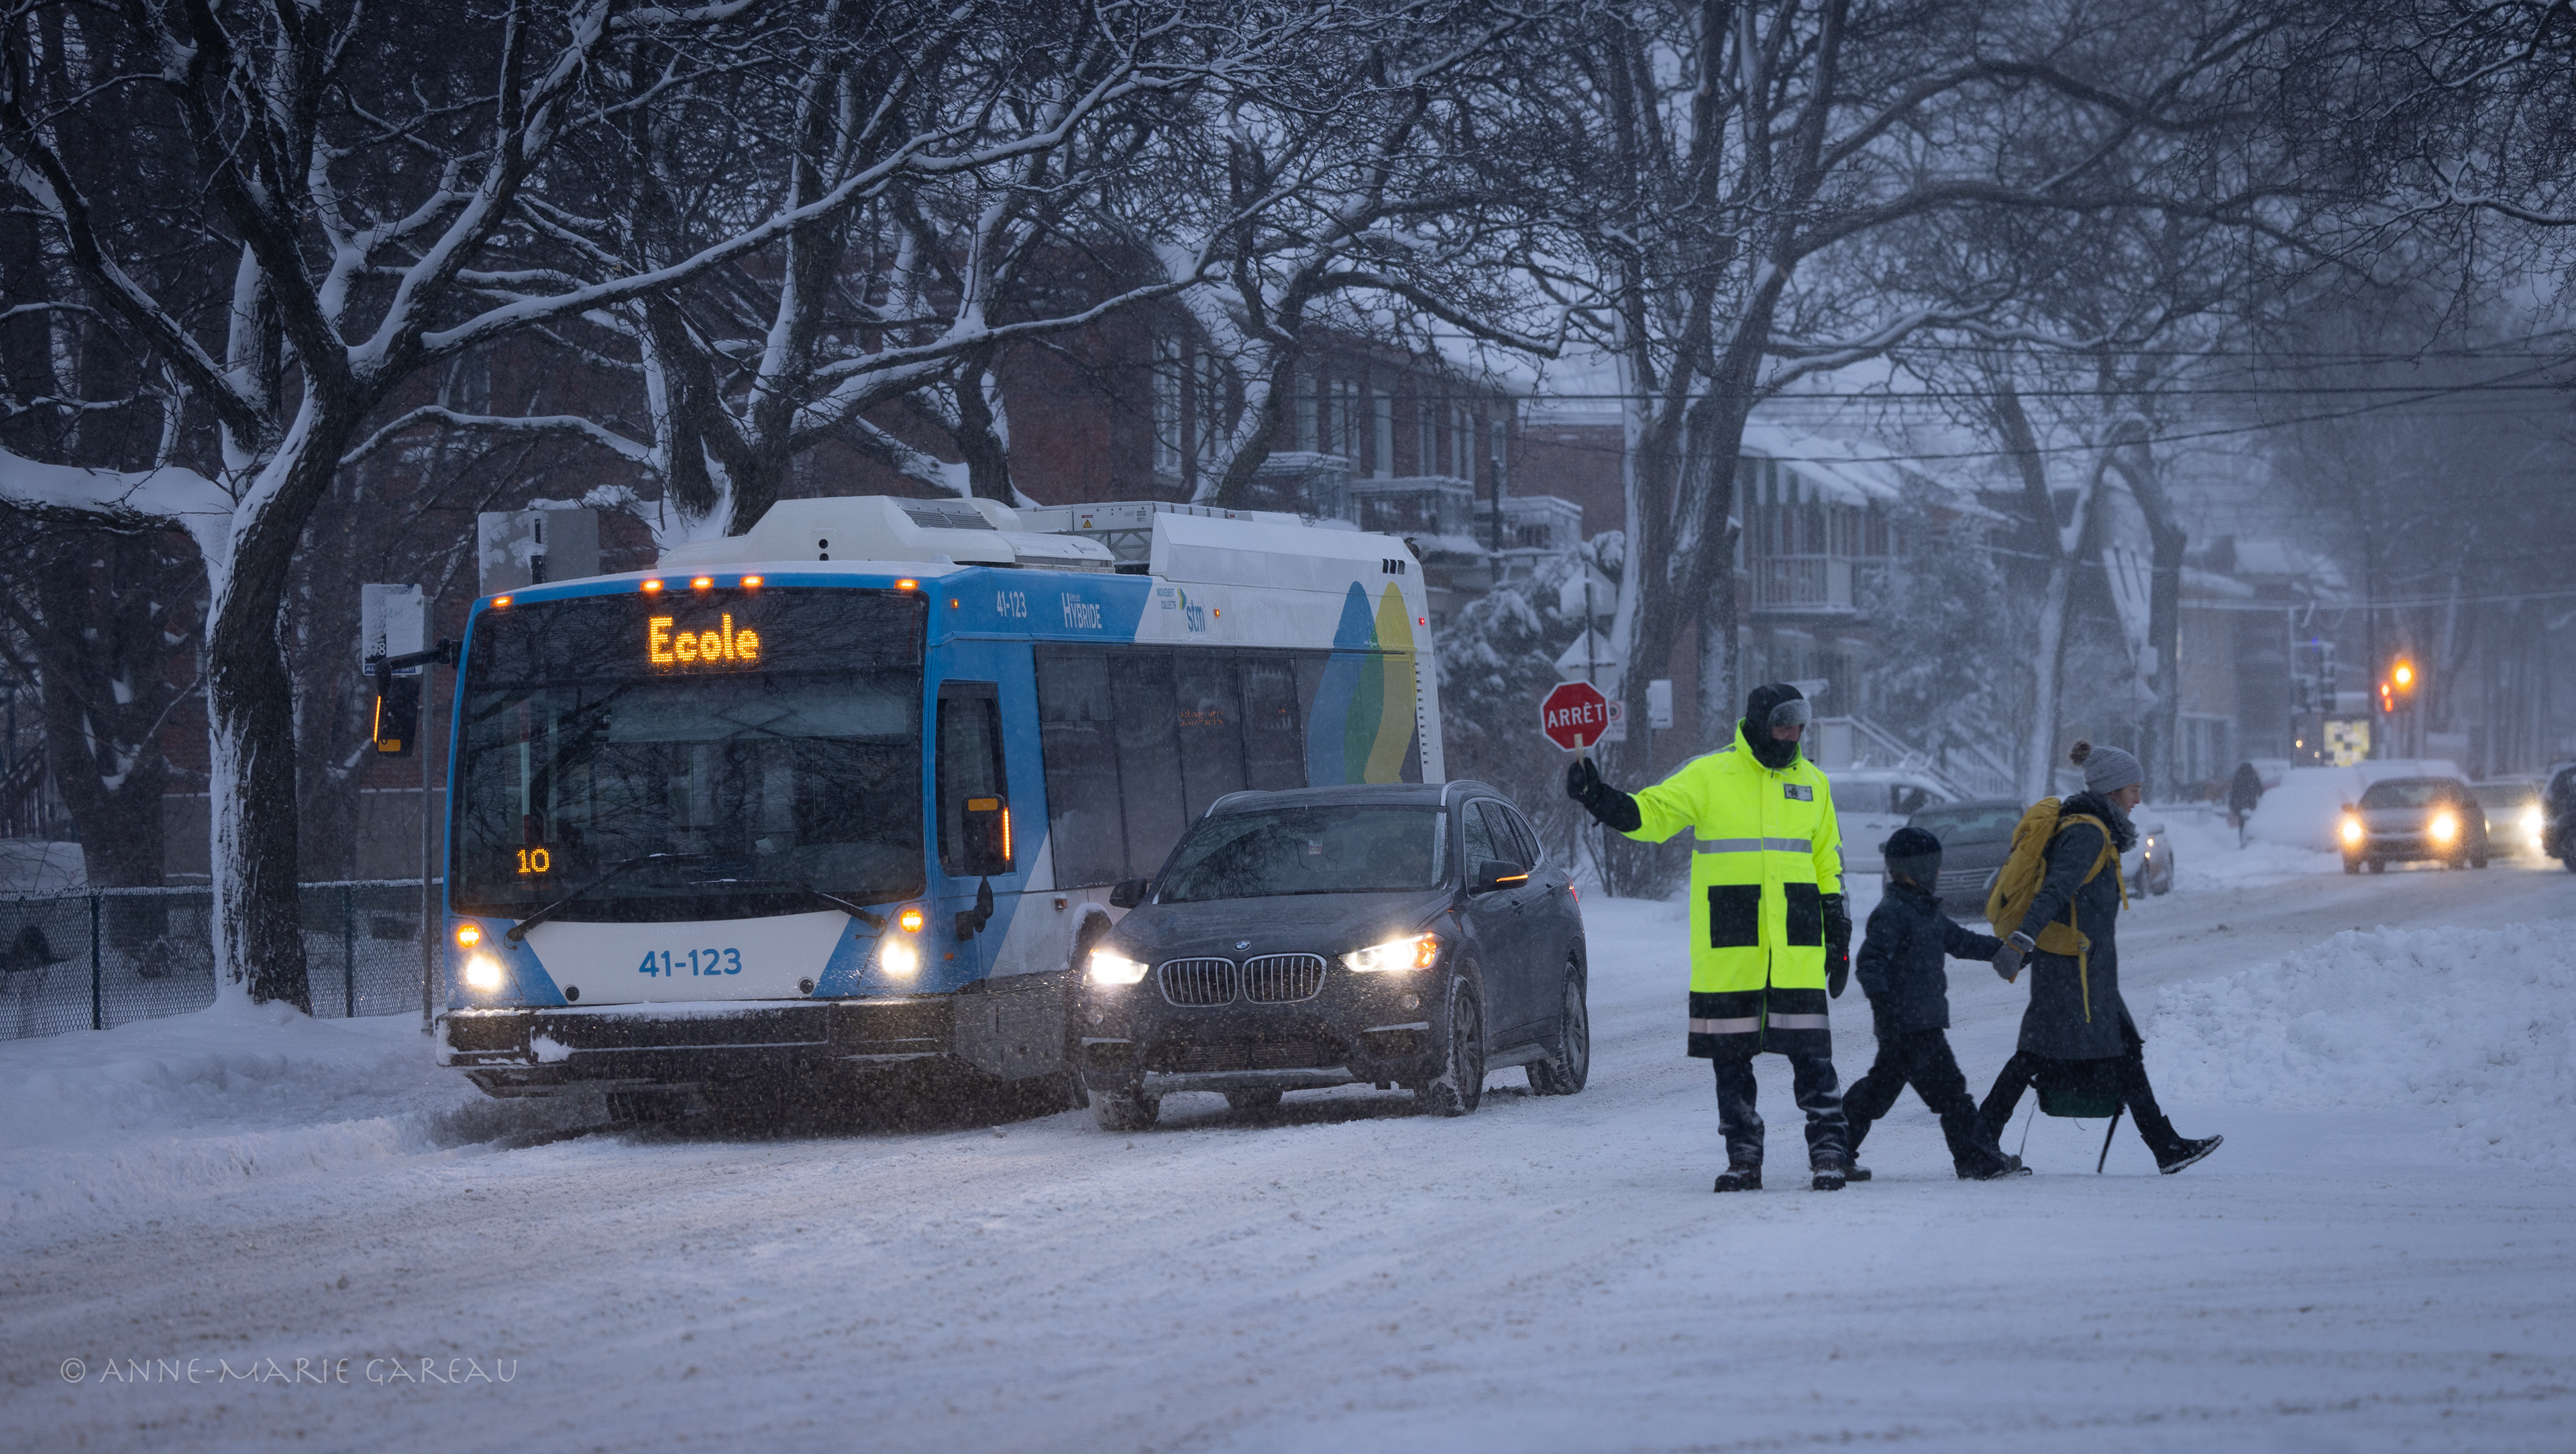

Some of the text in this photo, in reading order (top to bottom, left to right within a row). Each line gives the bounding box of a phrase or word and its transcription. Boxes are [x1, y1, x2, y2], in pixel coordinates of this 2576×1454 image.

[997, 590, 1026, 618] 41-123
[1187, 600, 1205, 632] stm
[648, 613, 761, 665] Ecole
[1548, 702, 1603, 728] ARRÊT
[517, 848, 550, 873] 10
[639, 948, 742, 977] 41-123
